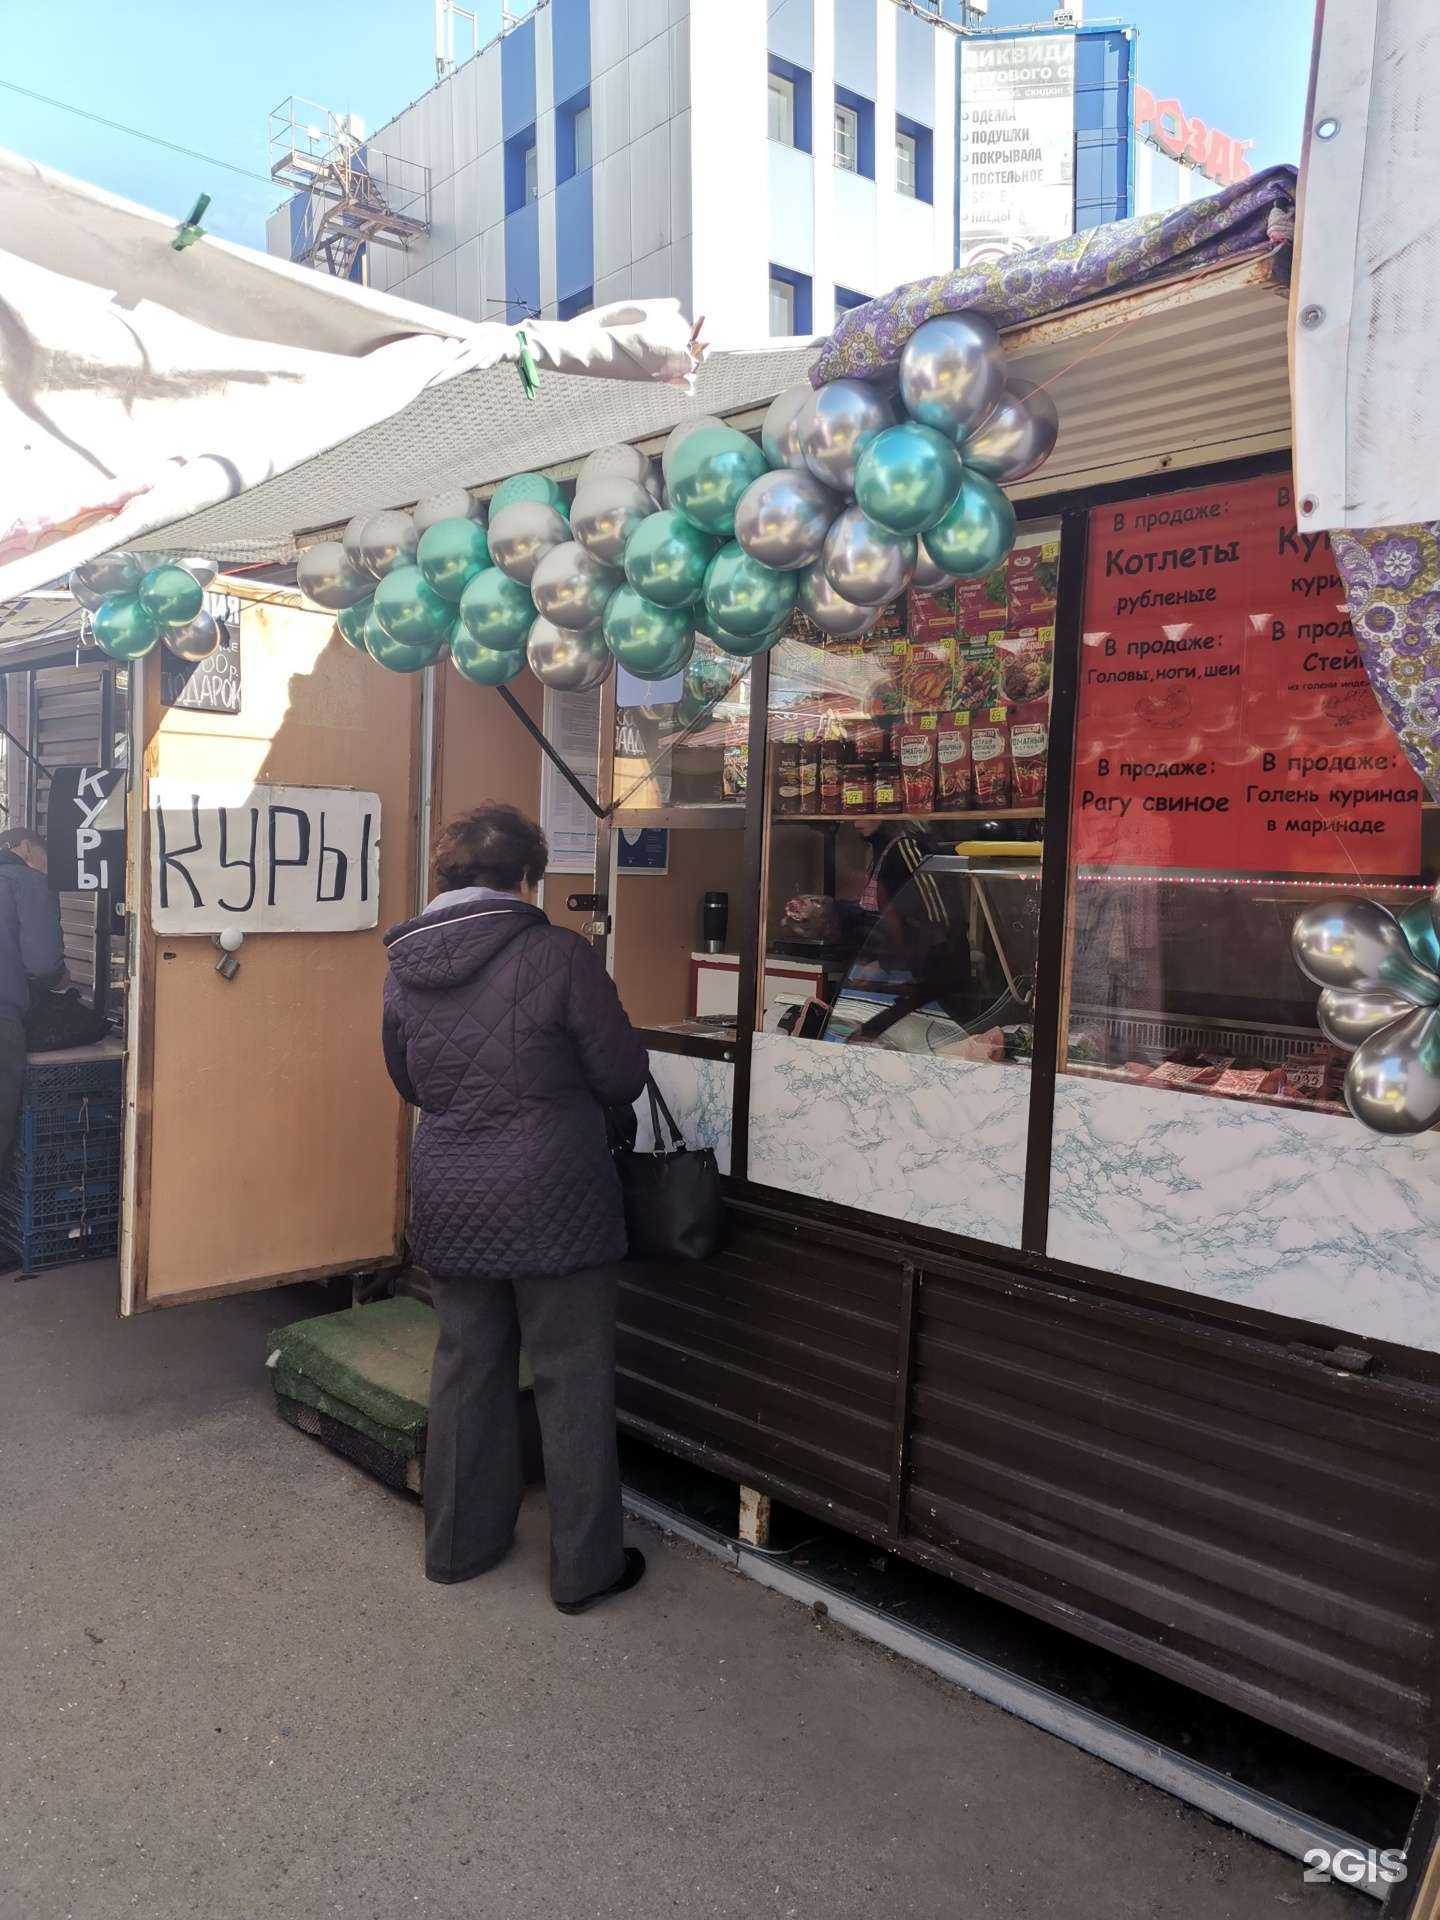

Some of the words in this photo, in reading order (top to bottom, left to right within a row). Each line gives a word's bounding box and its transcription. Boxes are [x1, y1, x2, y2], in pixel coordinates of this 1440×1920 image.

[971, 107, 1016, 125] ОДЕЯЛА
[971, 128, 1030, 145] ПОДУШКИ
[971, 148, 1042, 165] ПОКРЫВАЛА
[971, 168, 1044, 185] ПОСТЕЛЬНОЕ
[1278, 487, 1290, 507] В
[1113, 513, 1124, 531] В
[1135, 502, 1230, 531] продаже:
[1106, 541, 1240, 577] Котлеты
[1117, 586, 1217, 615] рубленые
[1272, 621, 1285, 641] В
[1105, 639, 1117, 656] В
[1127, 635, 1223, 659] продаже:
[1098, 759, 1110, 776] В
[1120, 759, 1216, 779] продаже:
[1263, 753, 1276, 772] В
[1288, 753, 1397, 773] продаже:
[1081, 790, 1132, 816] Рагу
[1142, 793, 1230, 813] свиное
[1246, 784, 1319, 803] Голень
[1328, 787, 1419, 807] куриная
[73, 767, 109, 890] КУРЫ
[1267, 818, 1276, 832] в
[1285, 817, 1386, 834] маринаде
[157, 794, 372, 913] КУРЫ
